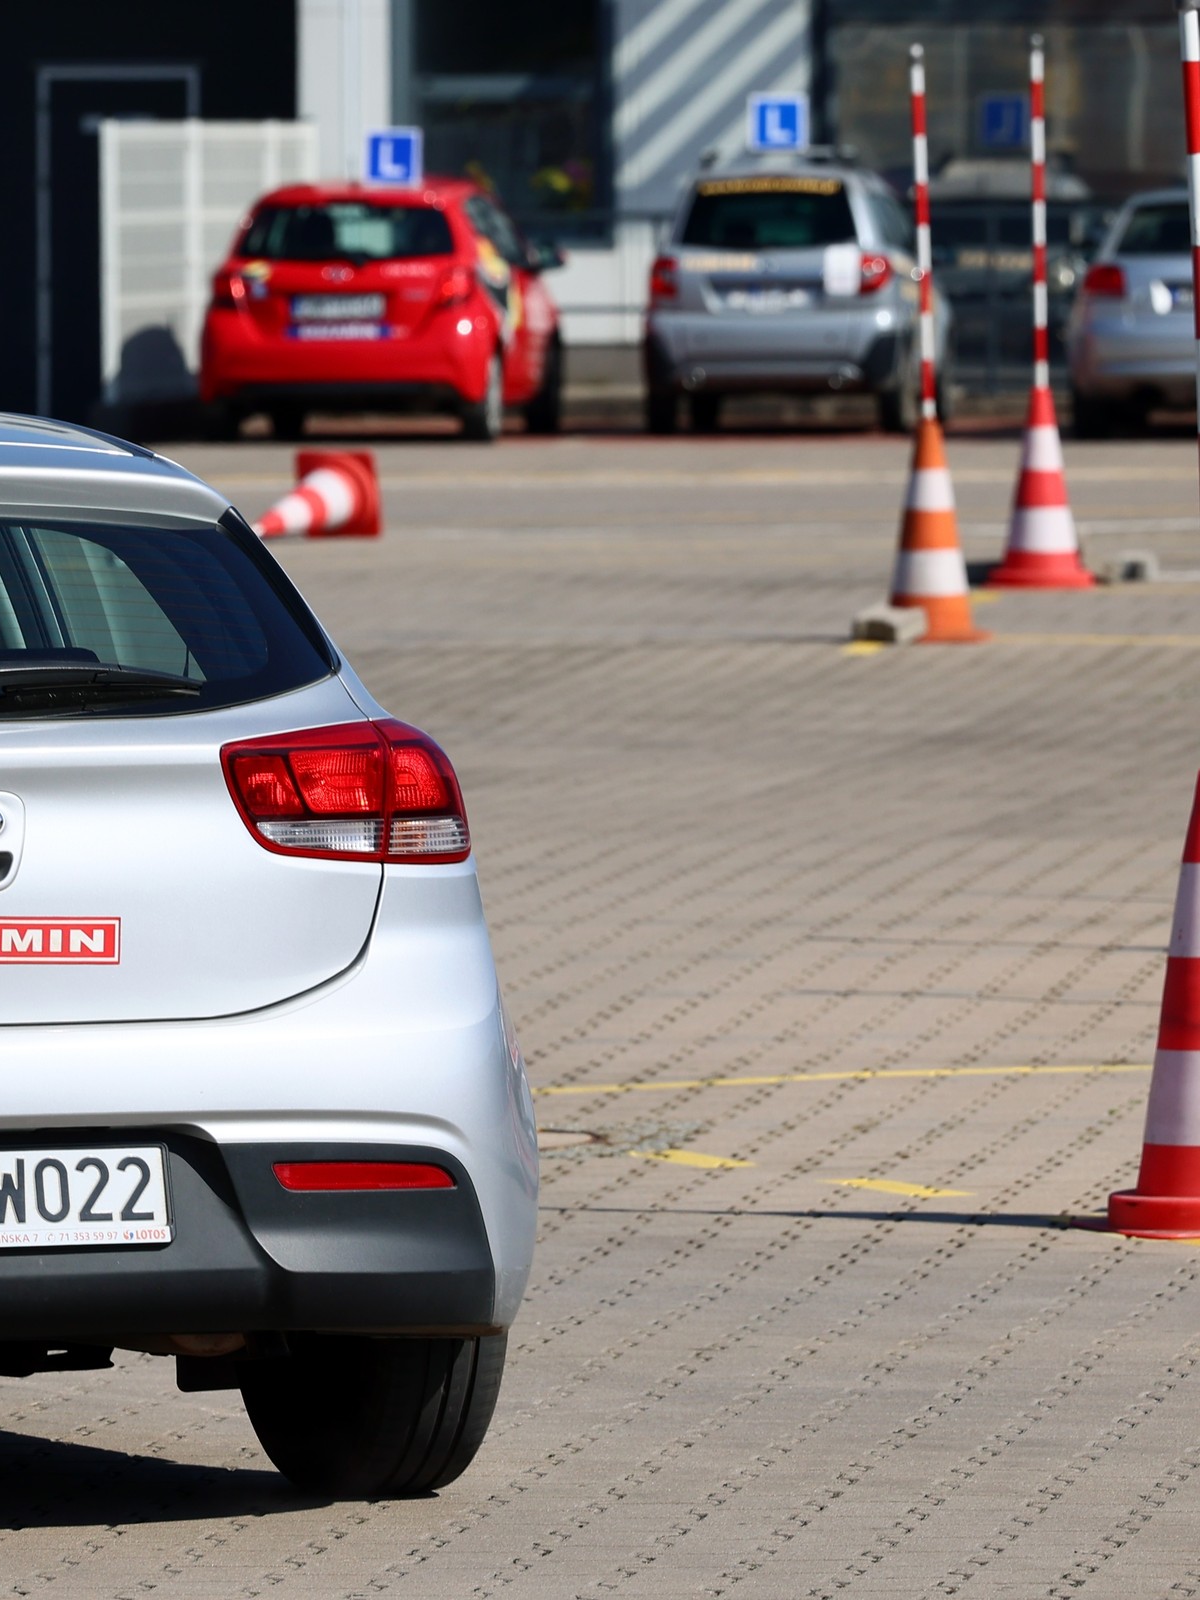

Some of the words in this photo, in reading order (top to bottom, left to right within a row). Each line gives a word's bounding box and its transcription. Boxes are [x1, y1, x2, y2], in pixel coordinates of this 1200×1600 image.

[766, 105, 794, 144] L
[378, 139, 407, 178] L
[33, 1233, 39, 1242] 7
[59, 1232, 70, 1241] 71
[74, 1232, 90, 1241] 353
[93, 1231, 105, 1241] 59
[107, 1231, 118, 1240] 97
[135, 1229, 166, 1240] LOTOS
